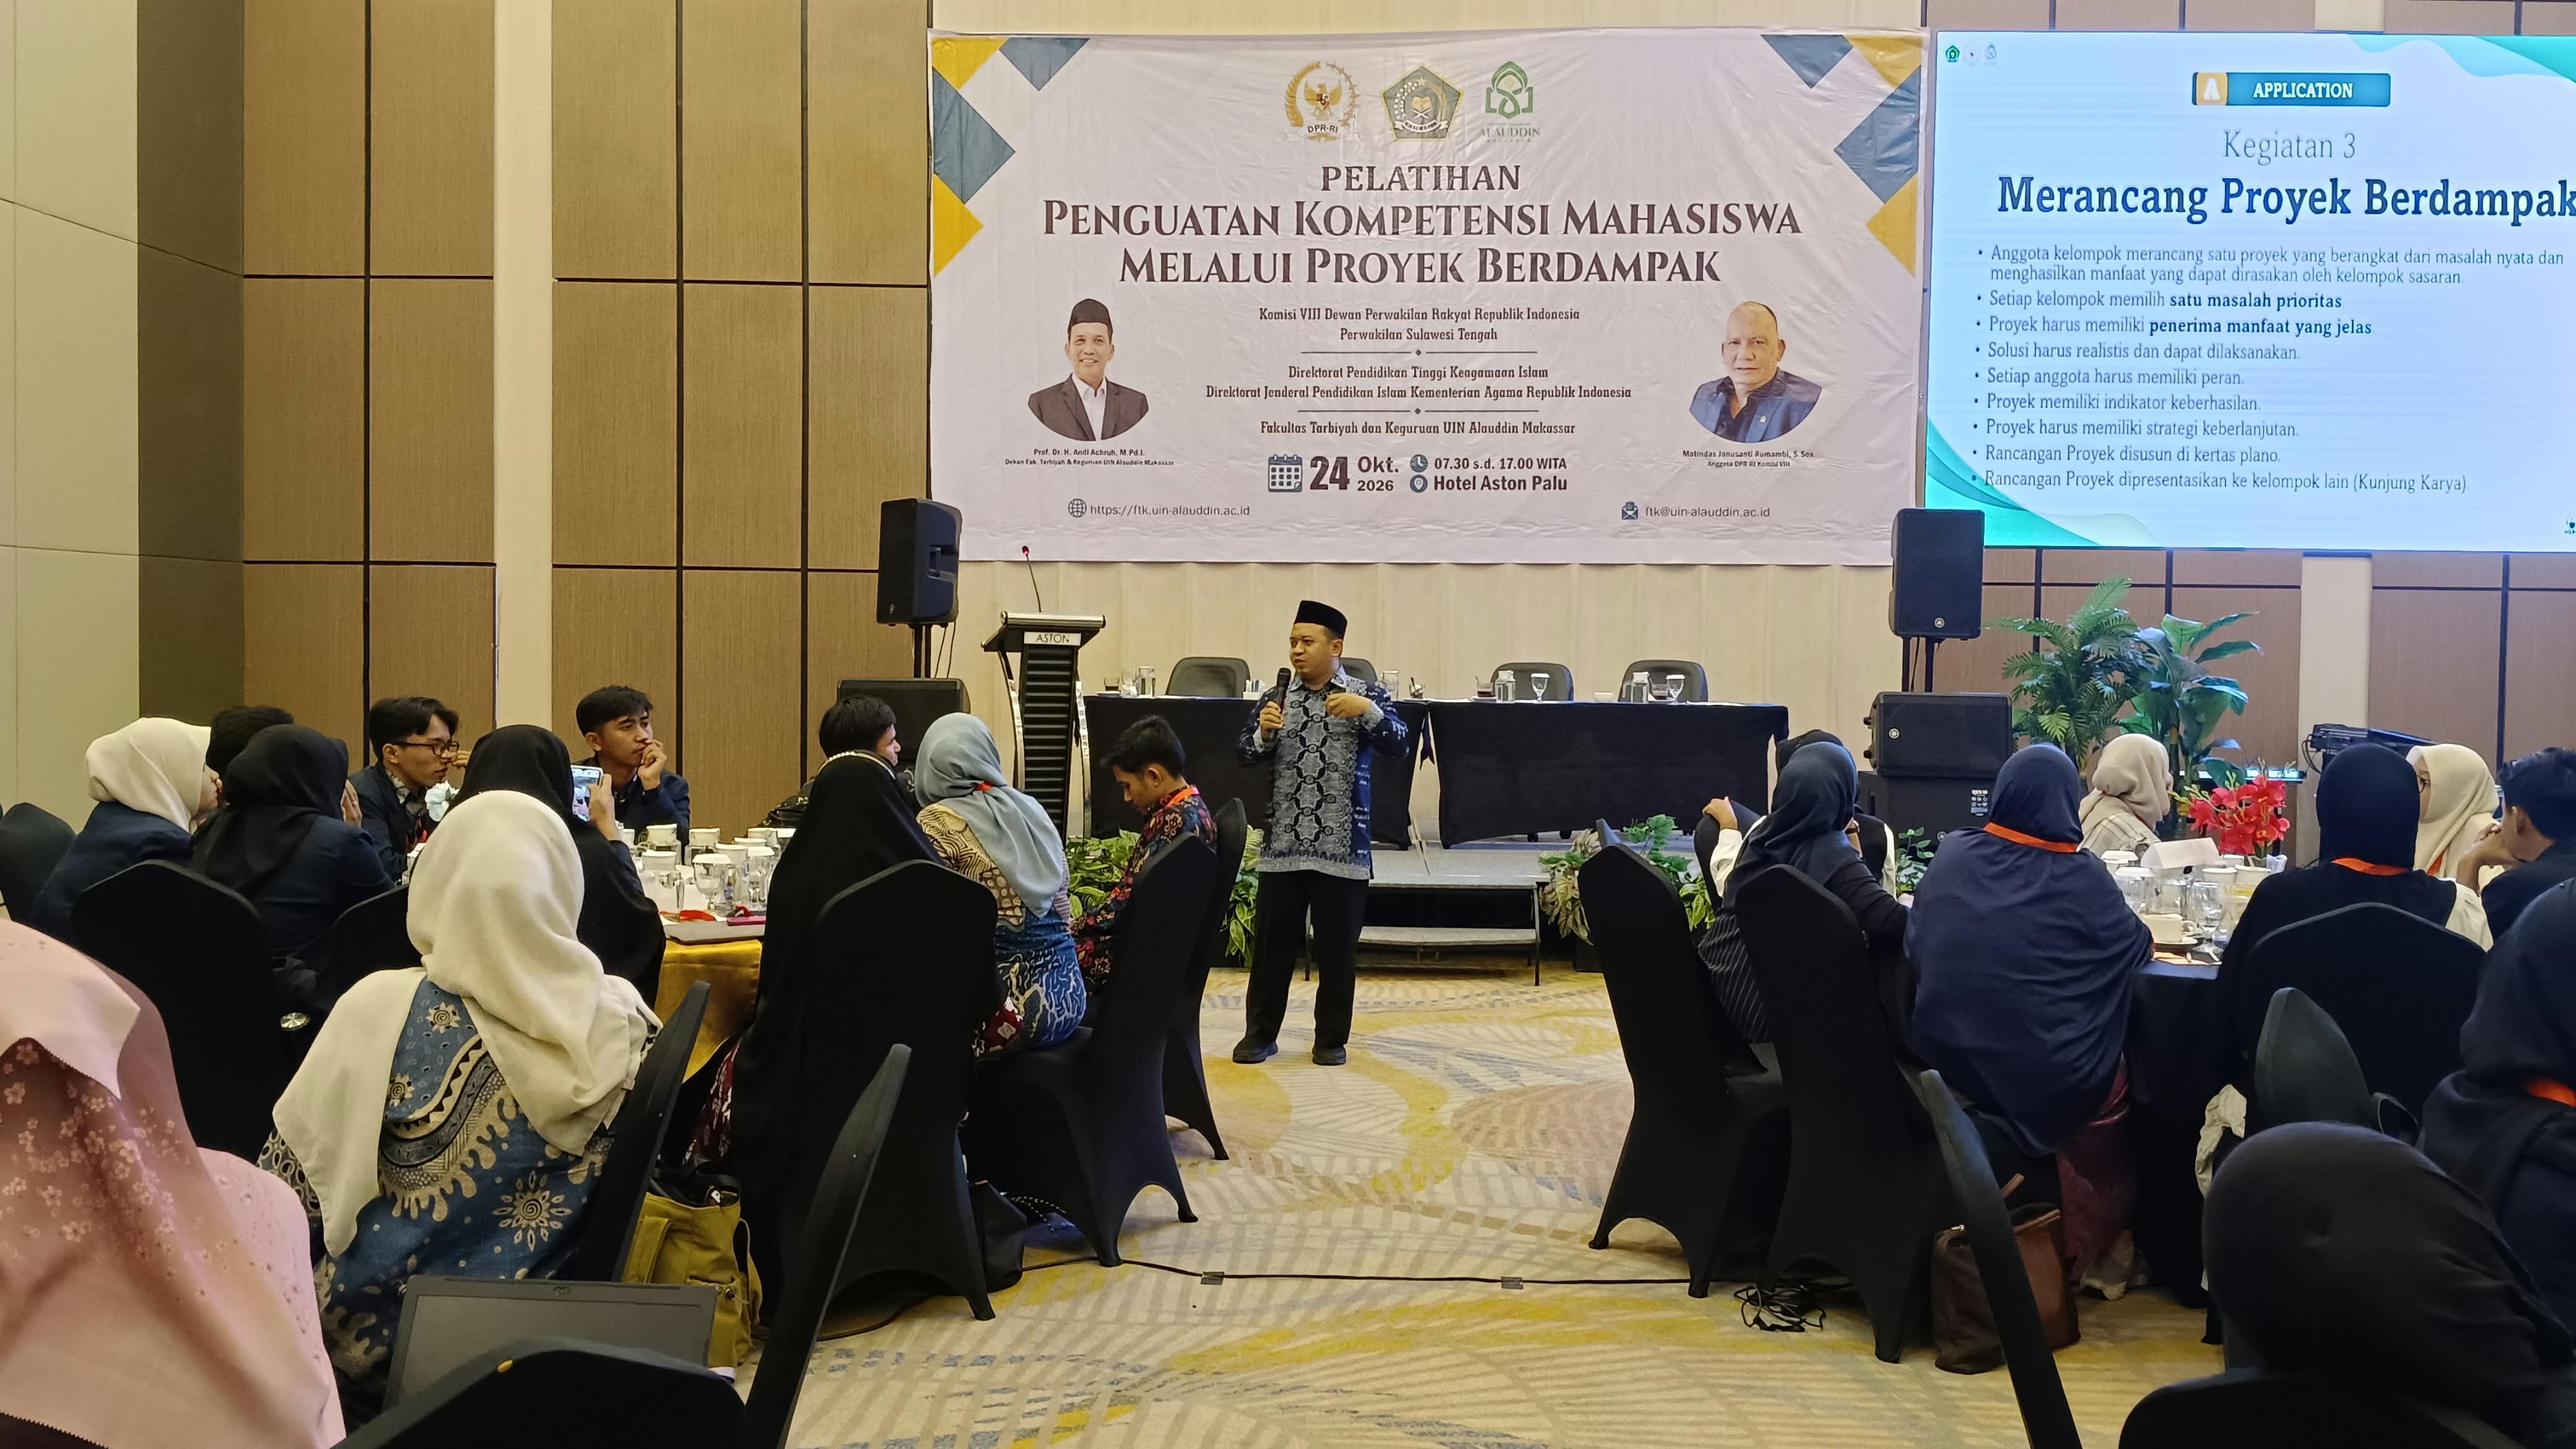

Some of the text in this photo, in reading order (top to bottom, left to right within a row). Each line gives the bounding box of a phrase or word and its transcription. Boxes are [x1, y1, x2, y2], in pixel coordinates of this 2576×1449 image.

[2203, 77, 2354, 101] A APPLICATION
[2224, 130, 2356, 166] Kegiatan 3
[1321, 165, 1521, 191] PELATIHAN
[1997, 176, 2576, 227] Merancang Proyek Berdampak
[1043, 199, 1803, 237] PENGUATAN KOMPETENSI MAHASISWA
[1119, 247, 1721, 284] MELALUI PROYEK BERDAMPAK
[1991, 244, 2564, 269] Anggota kelompok merancang satu proyek yang berangkat dari masalah nyata dan
[1991, 264, 2086, 285] menghasilkan
[2090, 265, 2146, 281] manfaat
[2150, 269, 2184, 285] yang
[2188, 266, 2226, 286] dapat
[2231, 266, 2298, 282] dirasakan
[2302, 267, 2331, 282] oleh
[2336, 267, 2404, 287] kelompok
[1990, 289, 2032, 310] Setiap
[2037, 290, 2105, 310] kelompok
[2110, 290, 2165, 307] memilih
[2170, 294, 2202, 307] satu
[2207, 292, 2271, 308] masalah
[1259, 307, 1580, 323] Komisi VIII Dewan Perwakilan Rakyat Republik Indonesia
[1340, 327, 1498, 344] Perwakilan Sulawesi Tengah
[1990, 315, 2037, 336] Proyek
[2042, 316, 2080, 332] harus
[2085, 316, 2144, 333] memiliki
[2149, 317, 2222, 337] penerima
[2227, 318, 2290, 333] manfaat
[2295, 322, 2332, 338] yang
[1988, 341, 2299, 363] Solusi harus realistis dan dapat dilaksanakan.
[1288, 365, 1549, 381] Direktorat Pendidikan Tinggi Keagamaan Islam
[1987, 367, 2244, 389] Setiap anggota harus memiliki peran.
[1206, 385, 1632, 401] Direktorat Jenderal Pendidikan Islam Kementerian Agama Republik Indonesia
[1987, 392, 2260, 413] Proyek memiliki indikator keberhasilan.
[1261, 420, 1576, 437] Fakultas Tarbiyah dan Keguruan UIN Alauddin Makassar
[1986, 418, 2299, 440] Proyek harus memiliki strategi keberlanjutan.
[1033, 448, 1051, 456] Prof.
[1063, 448, 1073, 456] H.
[1090, 448, 1118, 457] Achruh,
[1682, 450, 1717, 458] Matindas
[1717, 450, 1754, 458] Janusanti
[1754, 450, 1792, 459] Rumambi,
[1986, 444, 2280, 466] Rancangan Proyek disusun di kertas plano.
[1310, 455, 1351, 490] 24
[1357, 456, 1399, 473] Okt.
[1434, 457, 1567, 470] 07.30 s.d. 17.00 WITA
[1707, 460, 1733, 469] Anggota
[1357, 479, 1394, 492] 2026
[1434, 475, 1567, 491] Hotel Aston Palu
[1984, 470, 2061, 490] Rancangan
[2066, 470, 2115, 490] Proyek
[2119, 470, 2227, 491] dipresentasikan
[2232, 472, 2248, 488] ke
[2252, 472, 2320, 493] kelompok
[2324, 472, 2349, 489] lain
[2353, 473, 2416, 494] (Kunjung
[1090, 505, 1250, 517] https://ftk.uin-alauddin.ac.id
[1645, 506, 1770, 518] ftk@uin-alauddin.ac.id
[1035, 633, 1070, 643] ASTON
